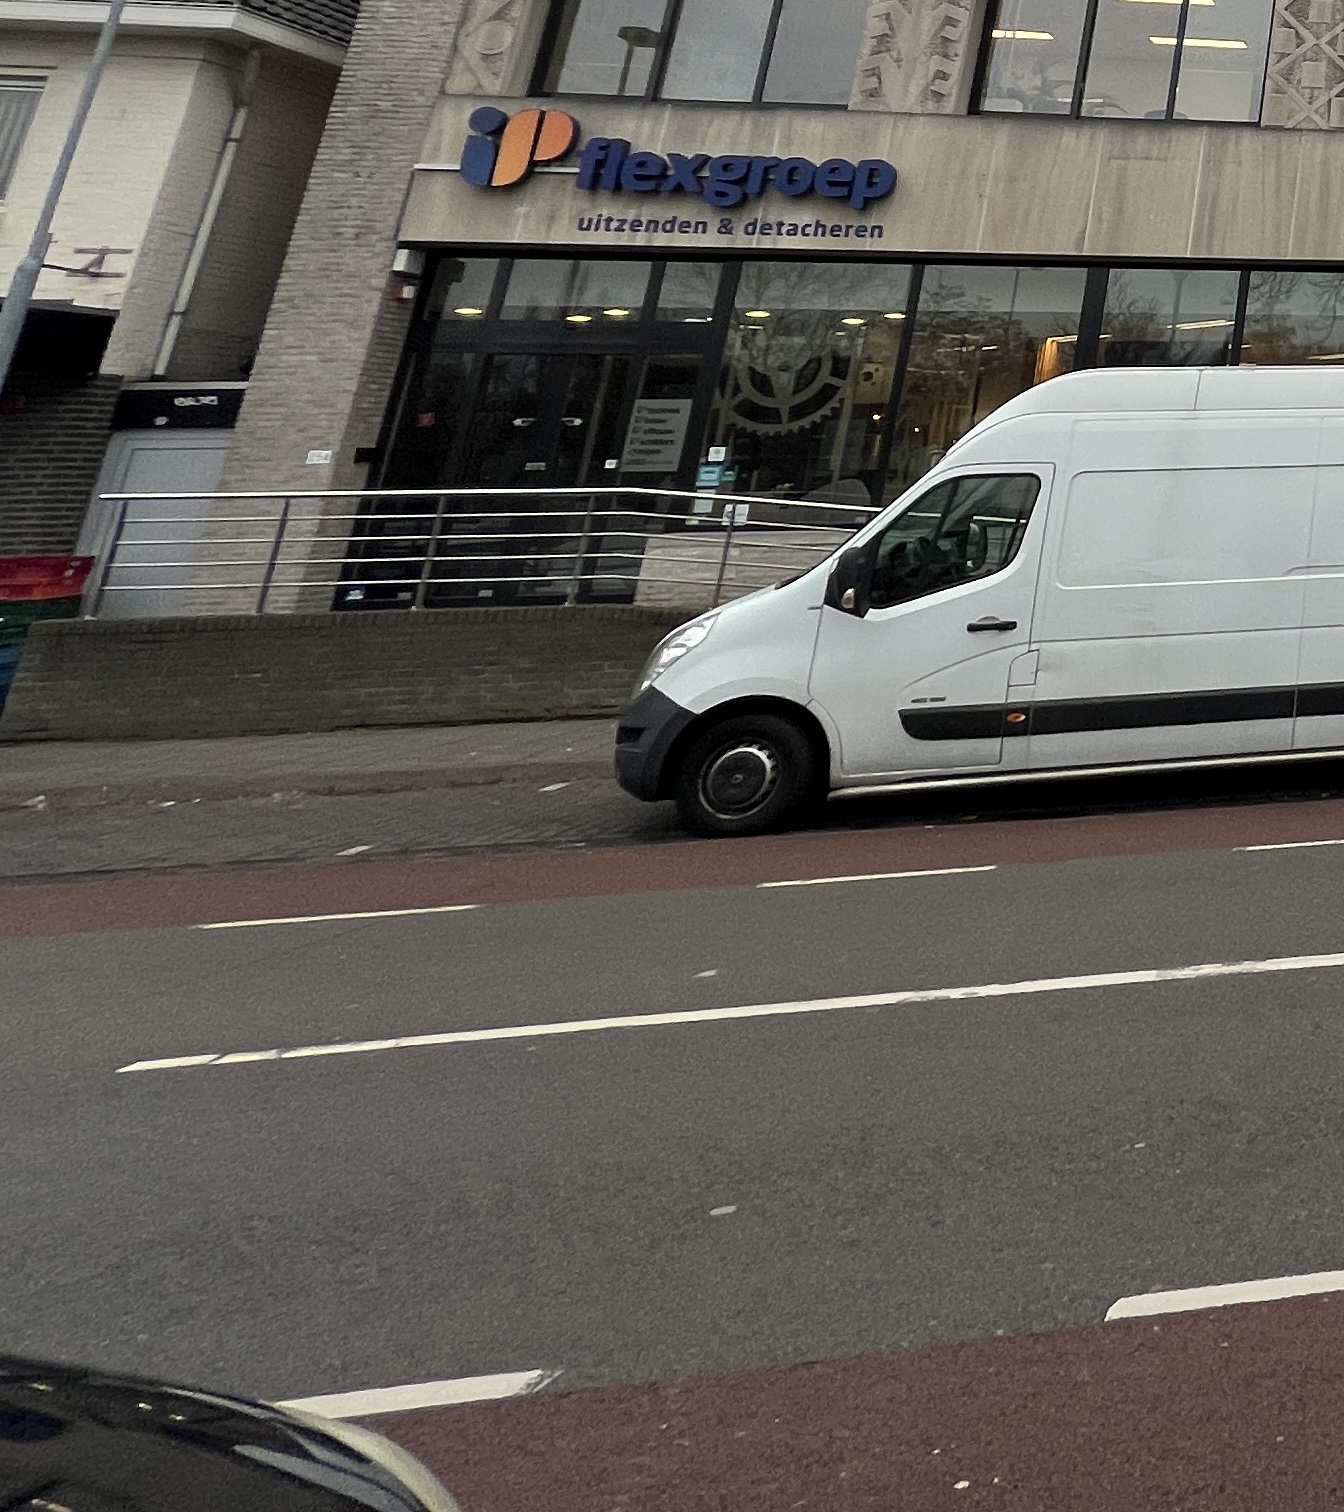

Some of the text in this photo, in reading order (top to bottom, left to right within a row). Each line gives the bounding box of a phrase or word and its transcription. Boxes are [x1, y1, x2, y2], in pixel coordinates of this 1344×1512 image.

[577, 137, 898, 209] flexgroep
[577, 213, 885, 240] uitzenden & detacheren
